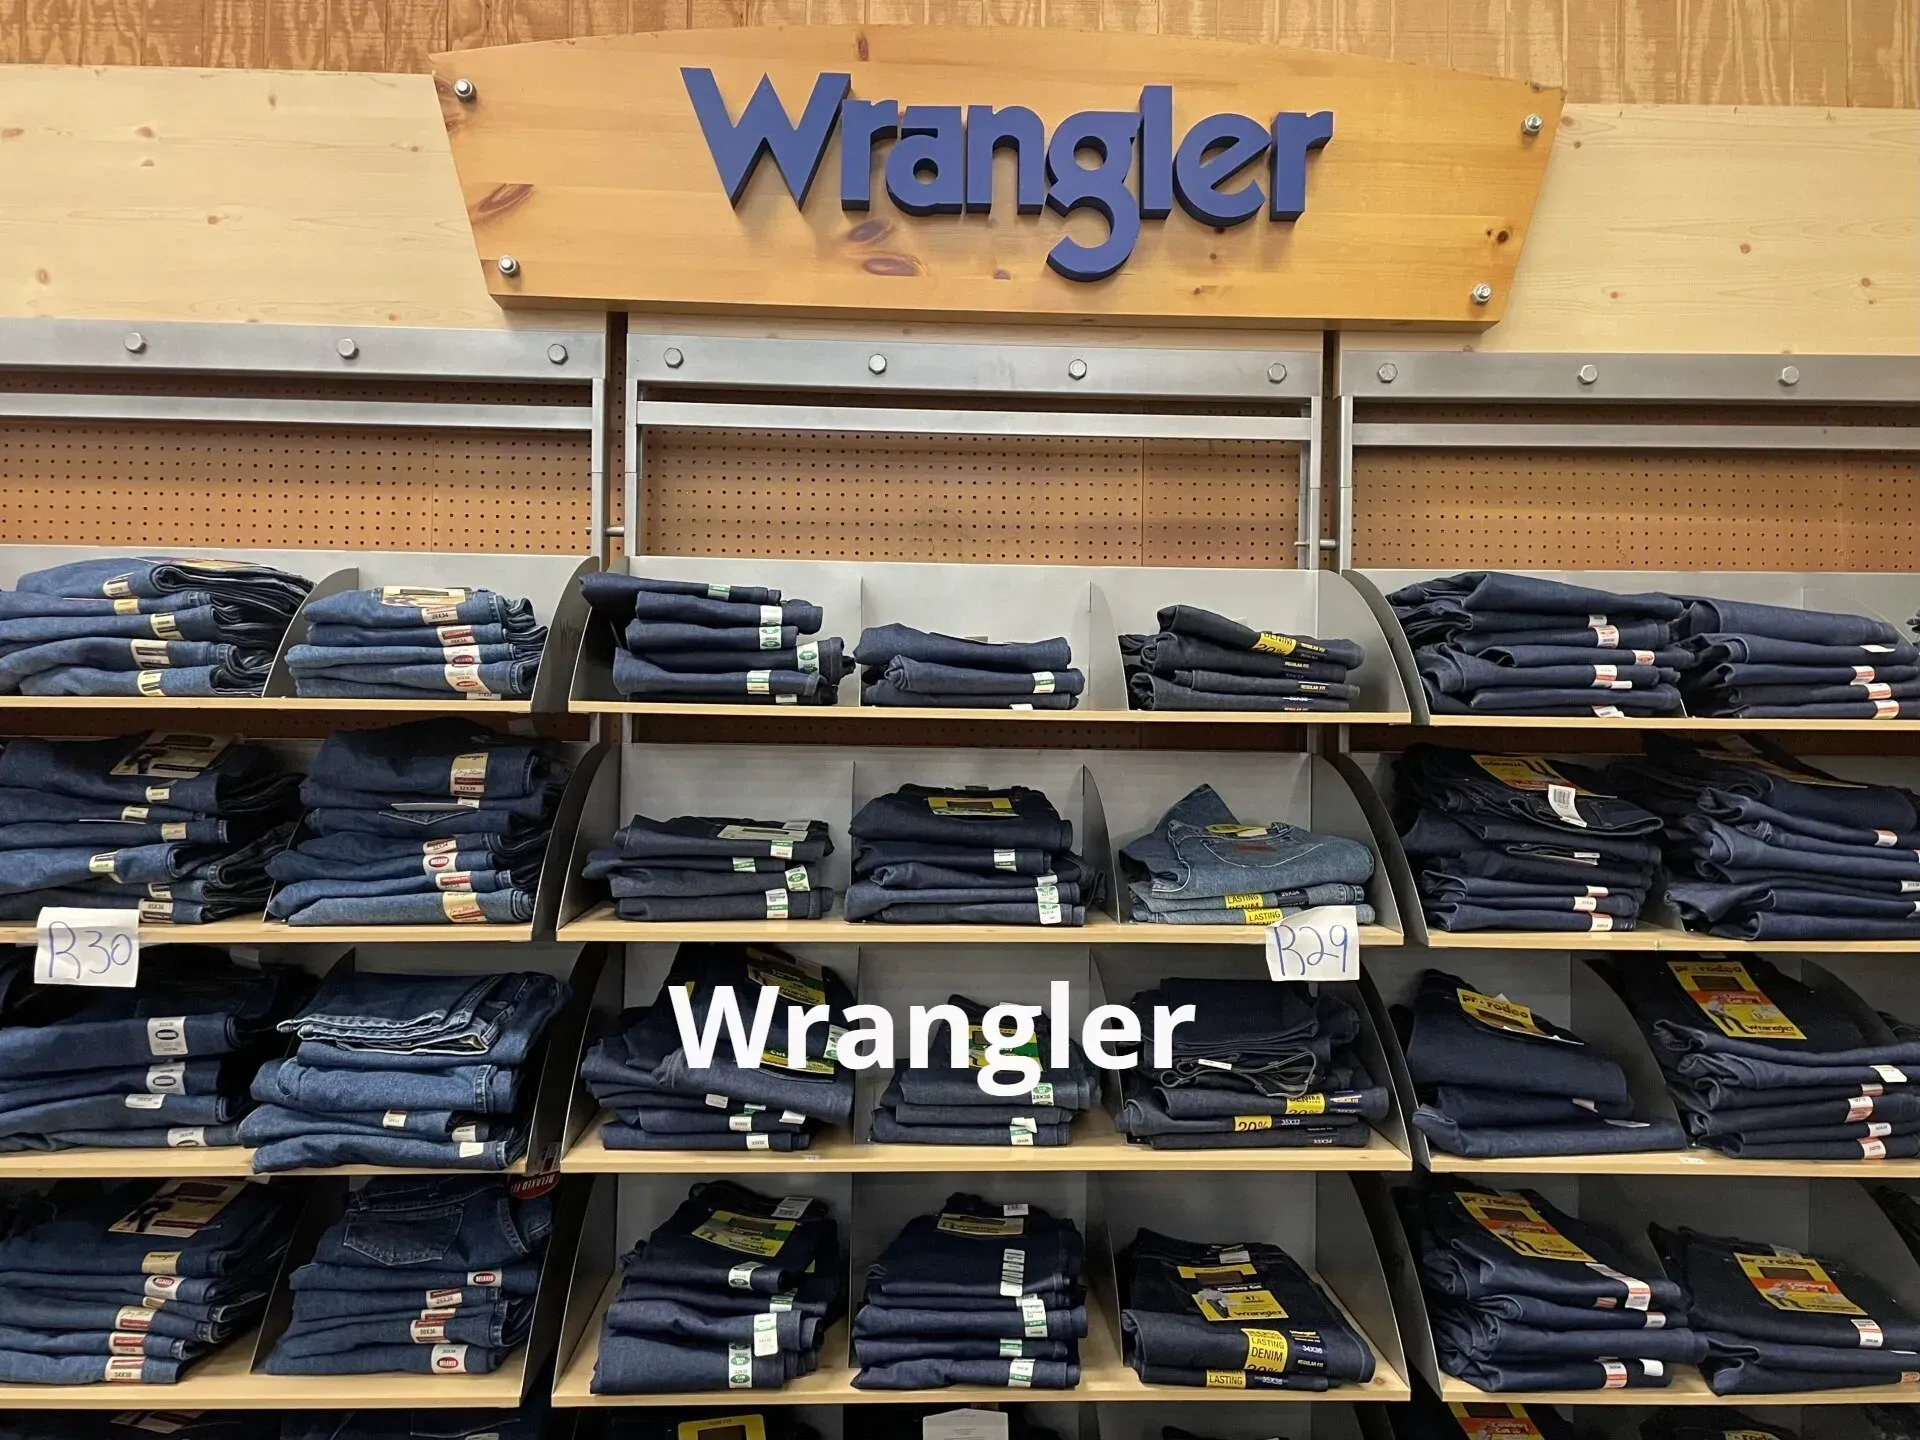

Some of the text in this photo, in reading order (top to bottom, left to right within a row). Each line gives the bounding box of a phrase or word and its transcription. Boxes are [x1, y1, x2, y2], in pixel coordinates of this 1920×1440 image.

[680, 66, 1334, 282] Wrangler
[1227, 893, 1260, 904] LASTING
[1248, 910, 1281, 922] LASTING
[1252, 1336, 1285, 1349] LASTING
[1250, 1346, 1283, 1362] DENIM
[1209, 1374, 1243, 1386] LASTING
